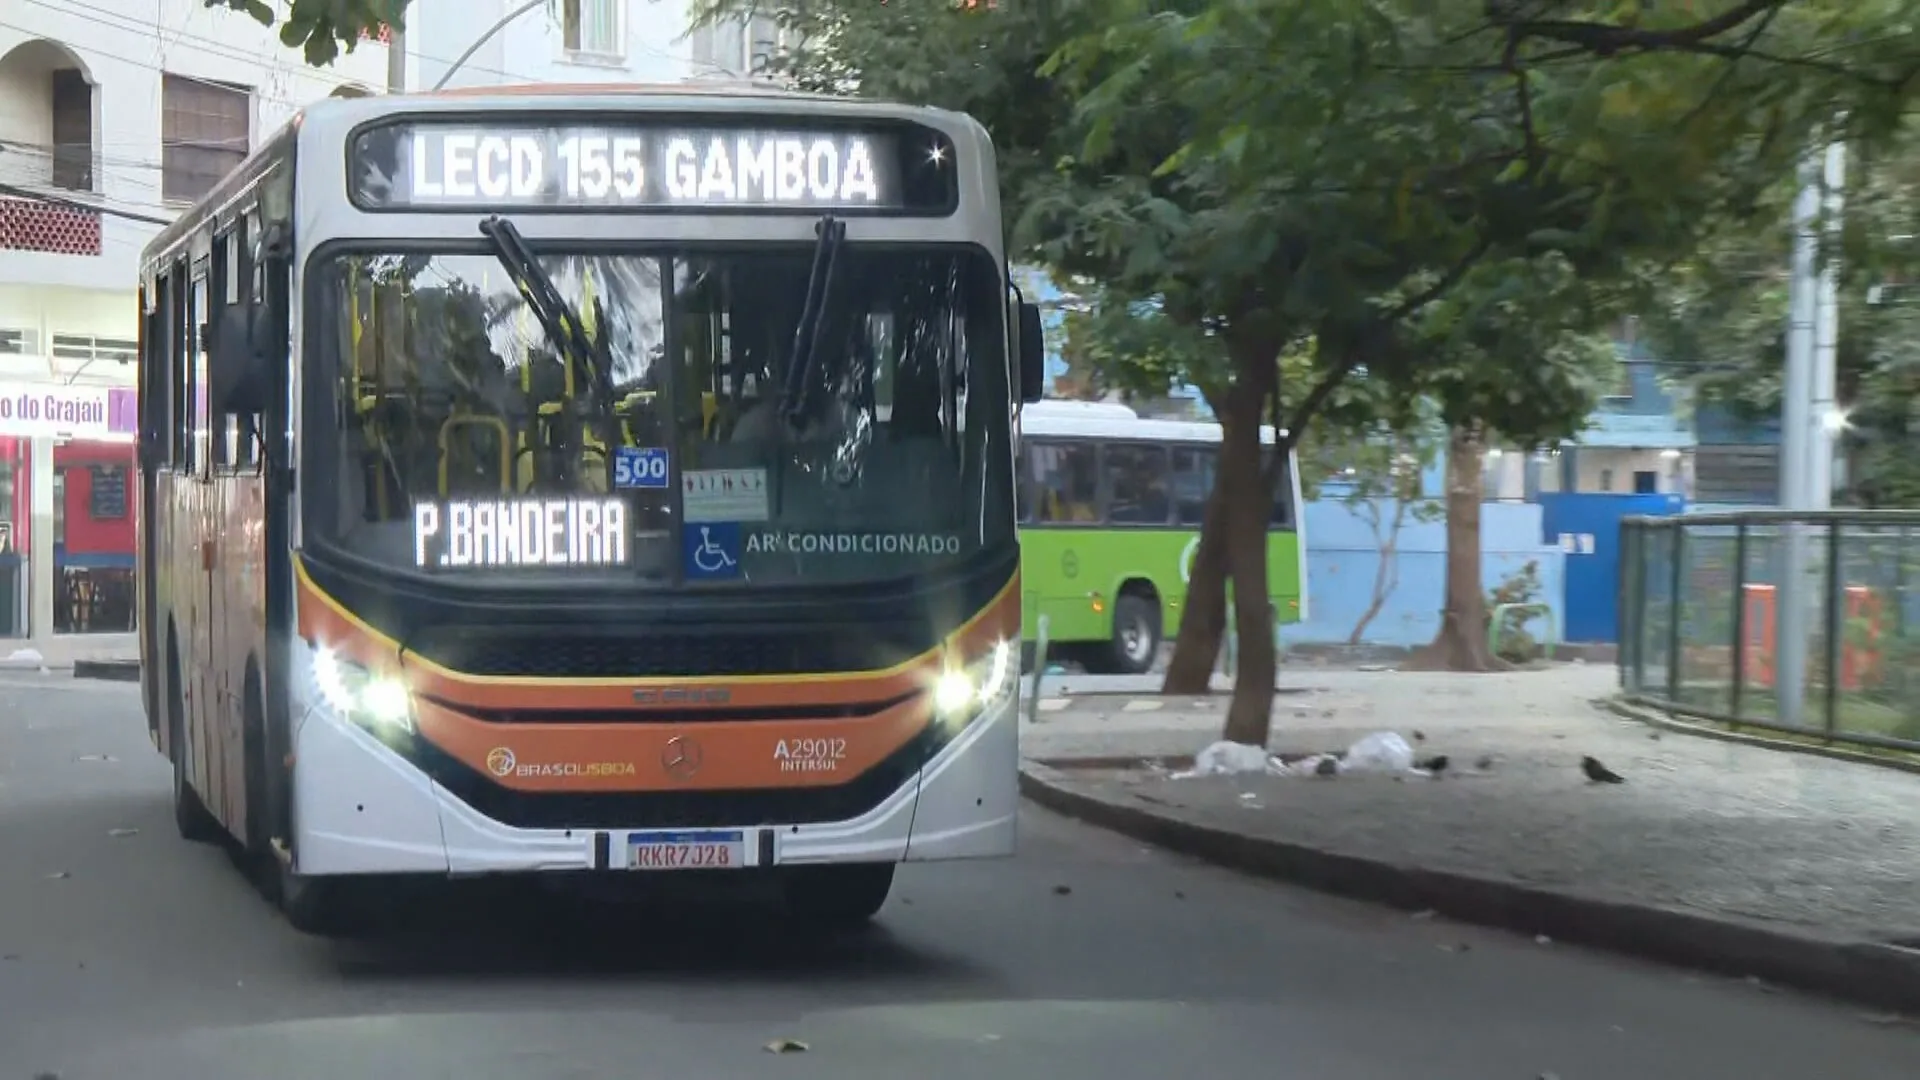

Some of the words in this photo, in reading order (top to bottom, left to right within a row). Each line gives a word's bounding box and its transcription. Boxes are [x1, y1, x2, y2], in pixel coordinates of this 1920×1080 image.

[412, 134, 543, 198] LECD
[557, 136, 645, 198] 155
[664, 137, 878, 202] GAMBOA
[17, 394, 39, 420] do
[44, 395, 103, 425] Grajaú
[415, 499, 626, 567] P.BANDEIRA
[746, 534, 776, 553] AR
[788, 533, 961, 555] CONDICIONADO
[773, 738, 847, 760] A29012
[780, 760, 836, 772] INTERSUL
[638, 845, 729, 866] RKR7J28
